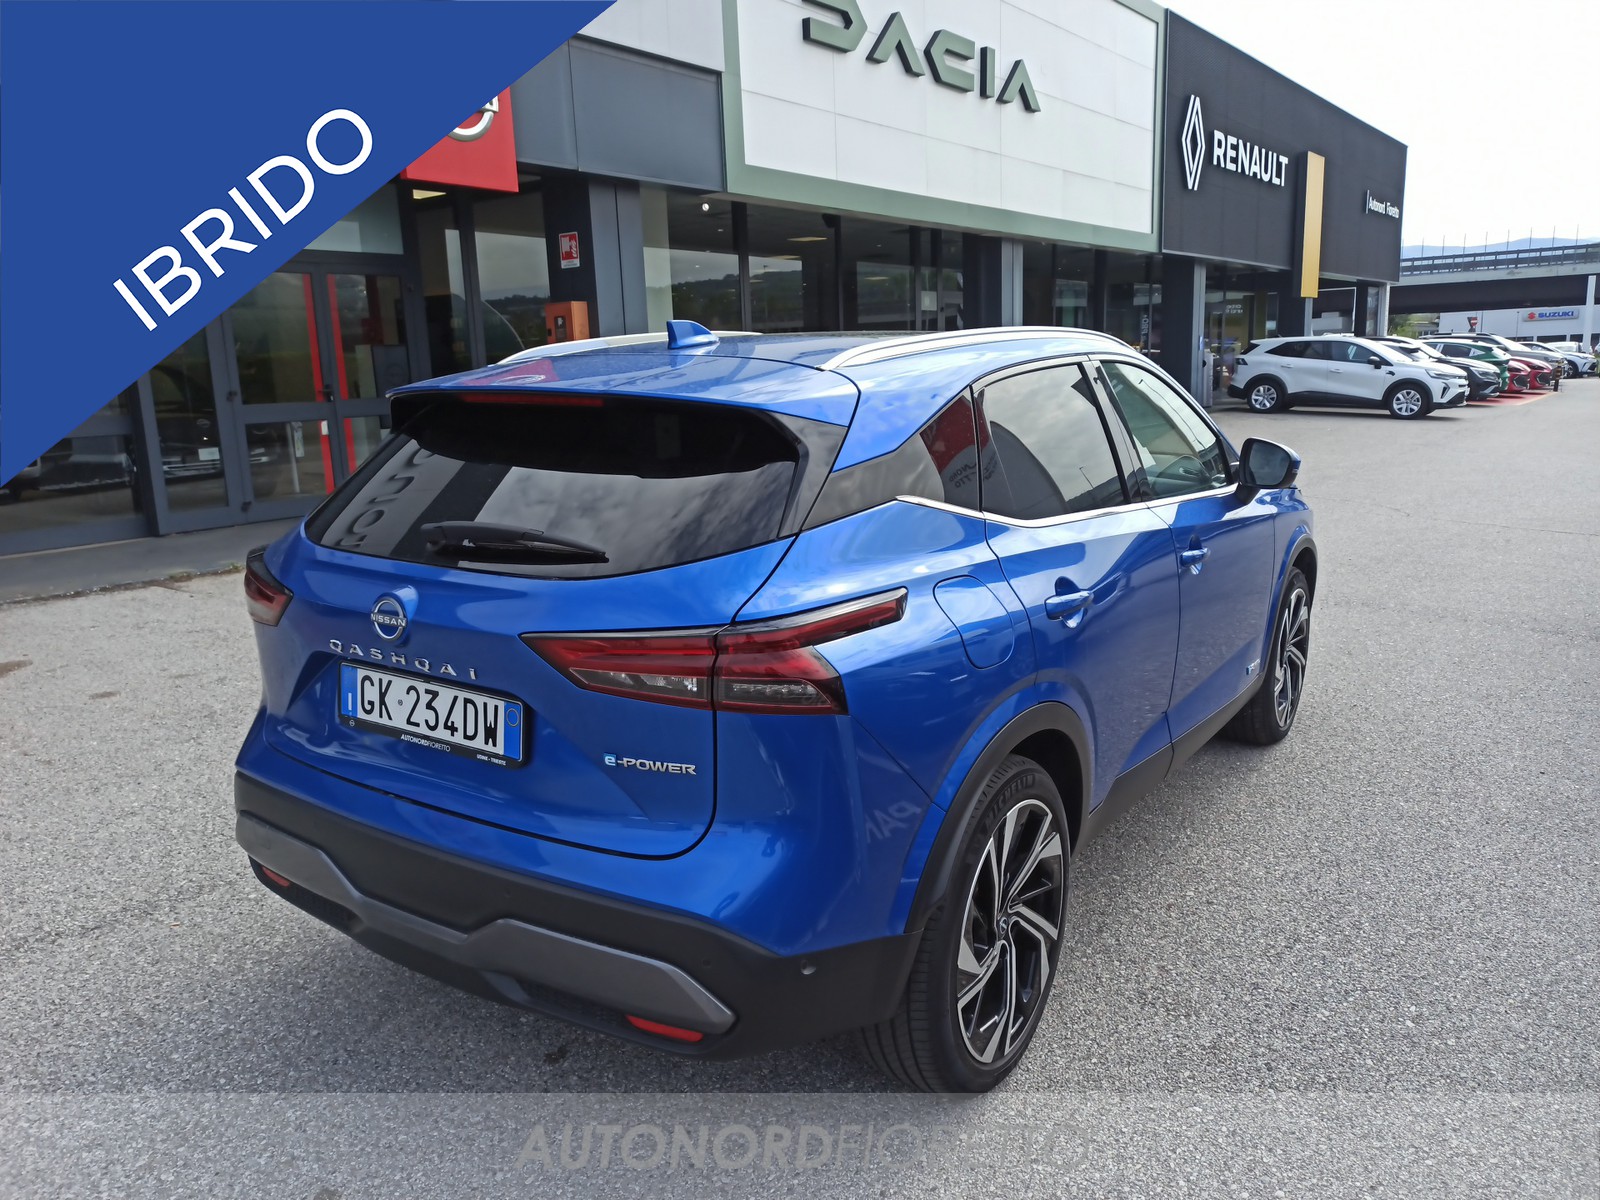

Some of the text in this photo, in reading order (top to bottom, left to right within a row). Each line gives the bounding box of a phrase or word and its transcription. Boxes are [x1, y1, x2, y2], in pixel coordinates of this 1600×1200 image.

[802, 0, 1041, 113] DACIA
[1212, 129, 1289, 187] RENAULT
[1538, 310, 1575, 318] SUZUKI
[371, 612, 406, 627] NISSAN
[329, 639, 477, 680] QASHQAI
[360, 674, 393, 721] GK
[405, 685, 499, 748] 234DW
[603, 754, 697, 775] e-POWER
